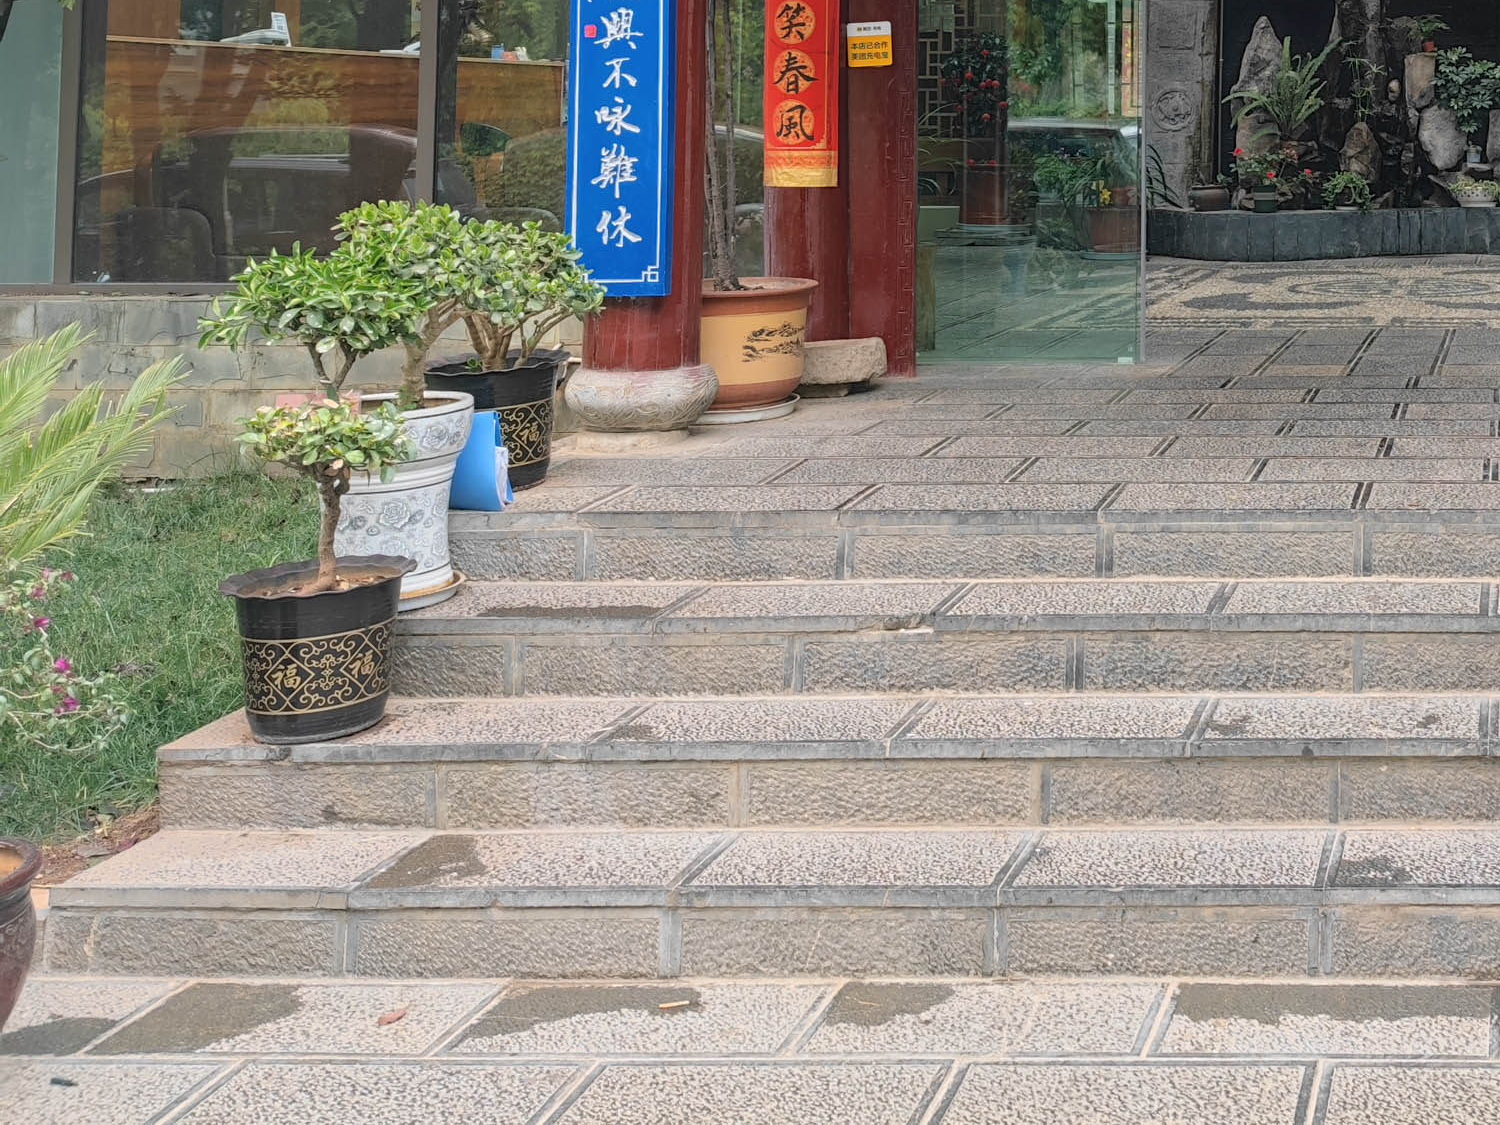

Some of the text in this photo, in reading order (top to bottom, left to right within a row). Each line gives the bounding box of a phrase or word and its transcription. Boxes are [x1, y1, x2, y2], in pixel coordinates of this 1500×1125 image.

[519, 420, 540, 445] 福
[271, 663, 301, 691] 福
[349, 649, 375, 679] 福
